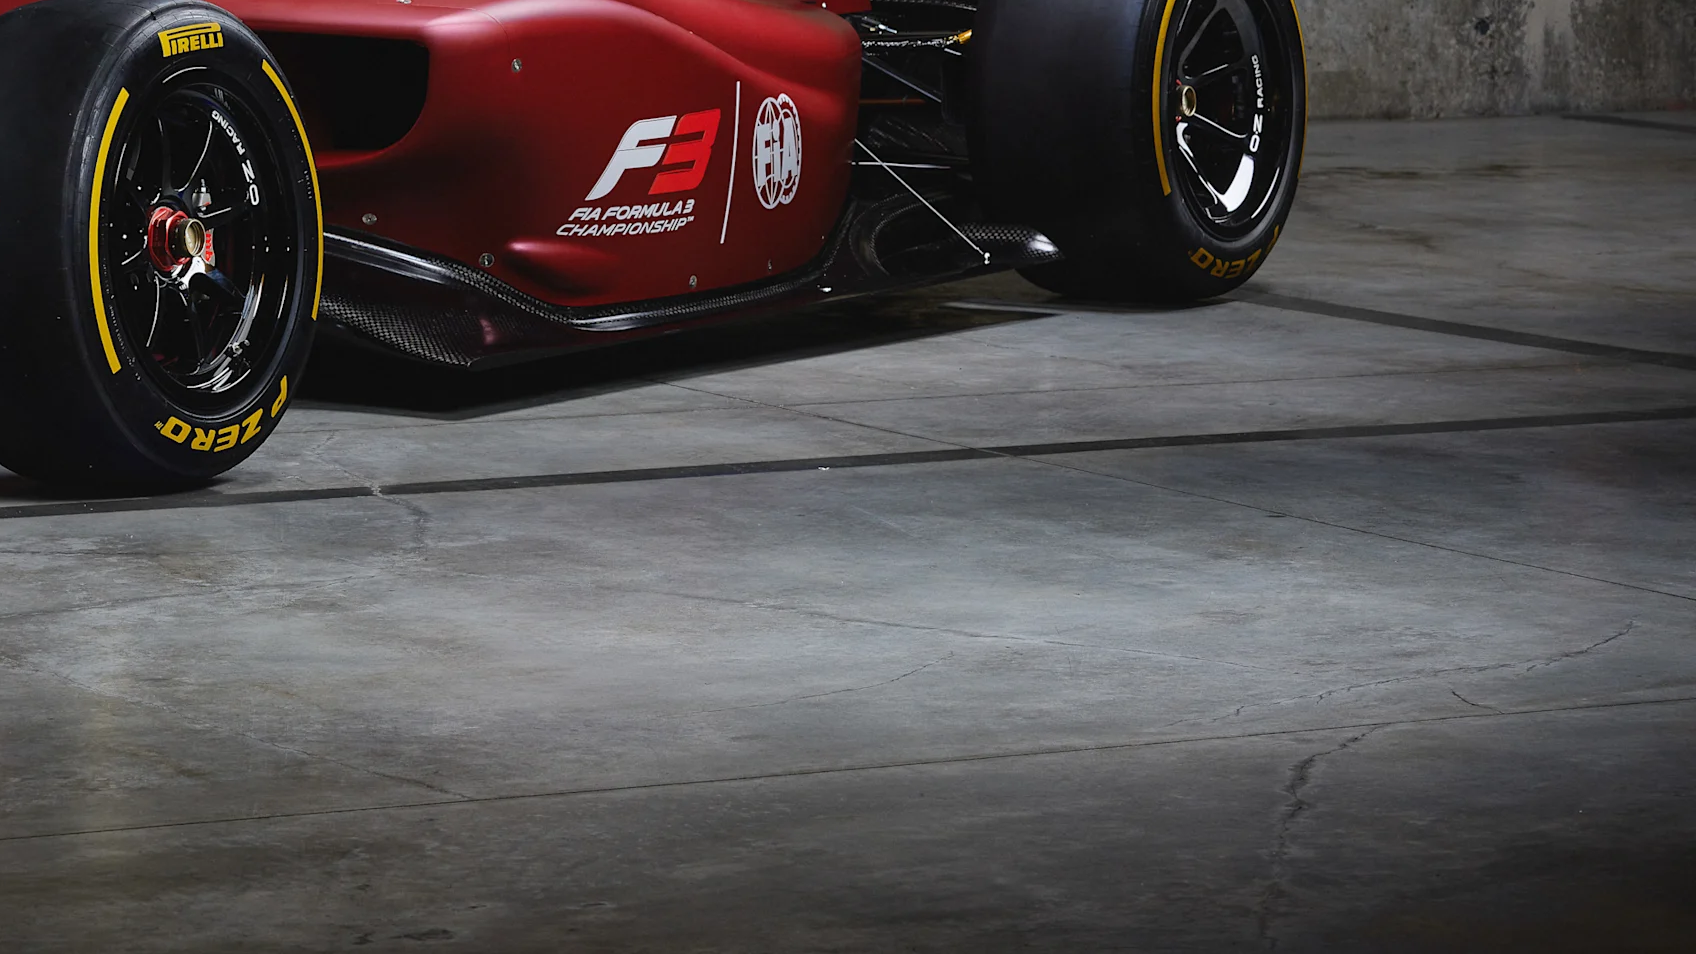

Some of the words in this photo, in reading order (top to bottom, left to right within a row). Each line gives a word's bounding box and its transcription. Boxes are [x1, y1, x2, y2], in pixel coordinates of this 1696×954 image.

[157, 22, 224, 58] PIRELLI
[1251, 54, 1264, 108] RACING
[211, 109, 246, 156] RACING
[585, 108, 721, 201] F3
[568, 207, 603, 221] FIA
[601, 200, 683, 220] FORMULA
[682, 198, 695, 214] 3
[270, 375, 288, 418] P
